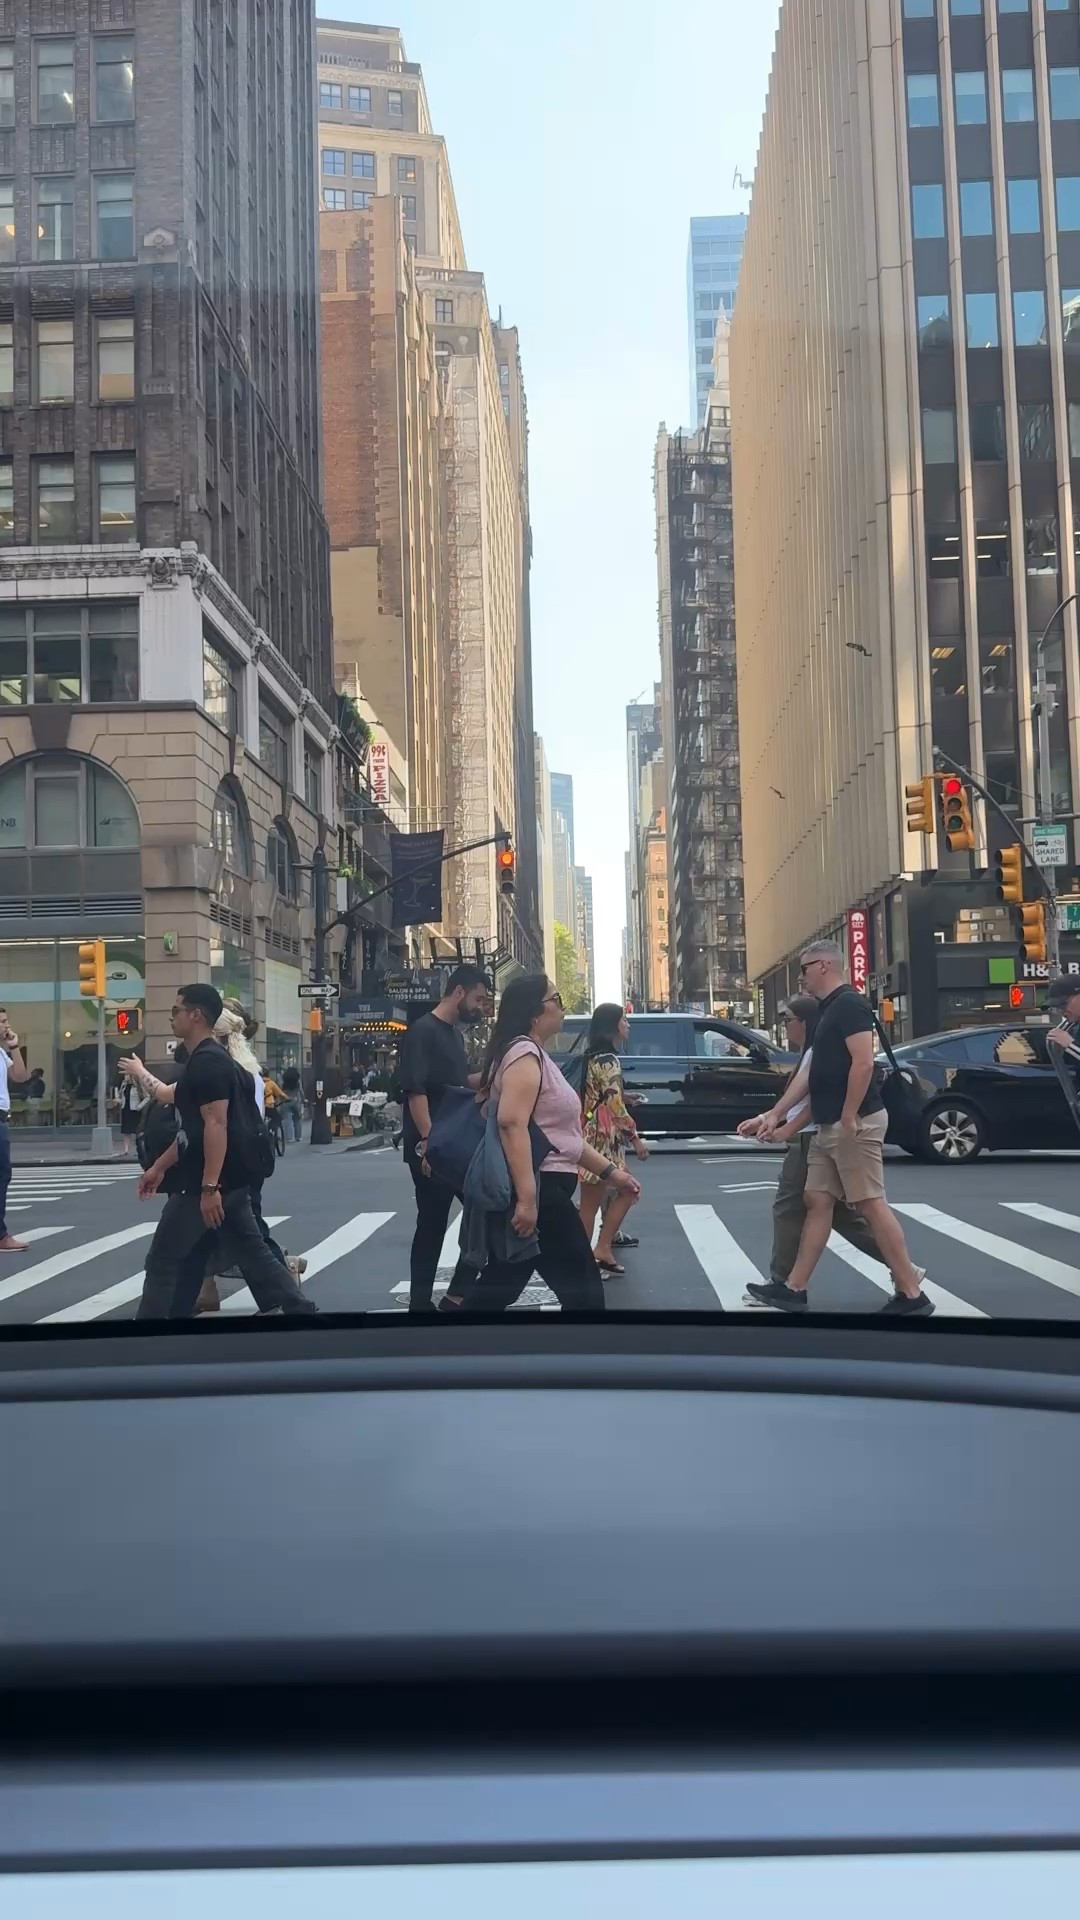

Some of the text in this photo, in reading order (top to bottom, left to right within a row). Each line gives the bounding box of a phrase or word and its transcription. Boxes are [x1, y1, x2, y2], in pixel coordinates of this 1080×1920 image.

[373, 765, 387, 800] PIZZA
[1036, 847, 1064, 856] SHARED
[853, 931, 866, 981] PARK
